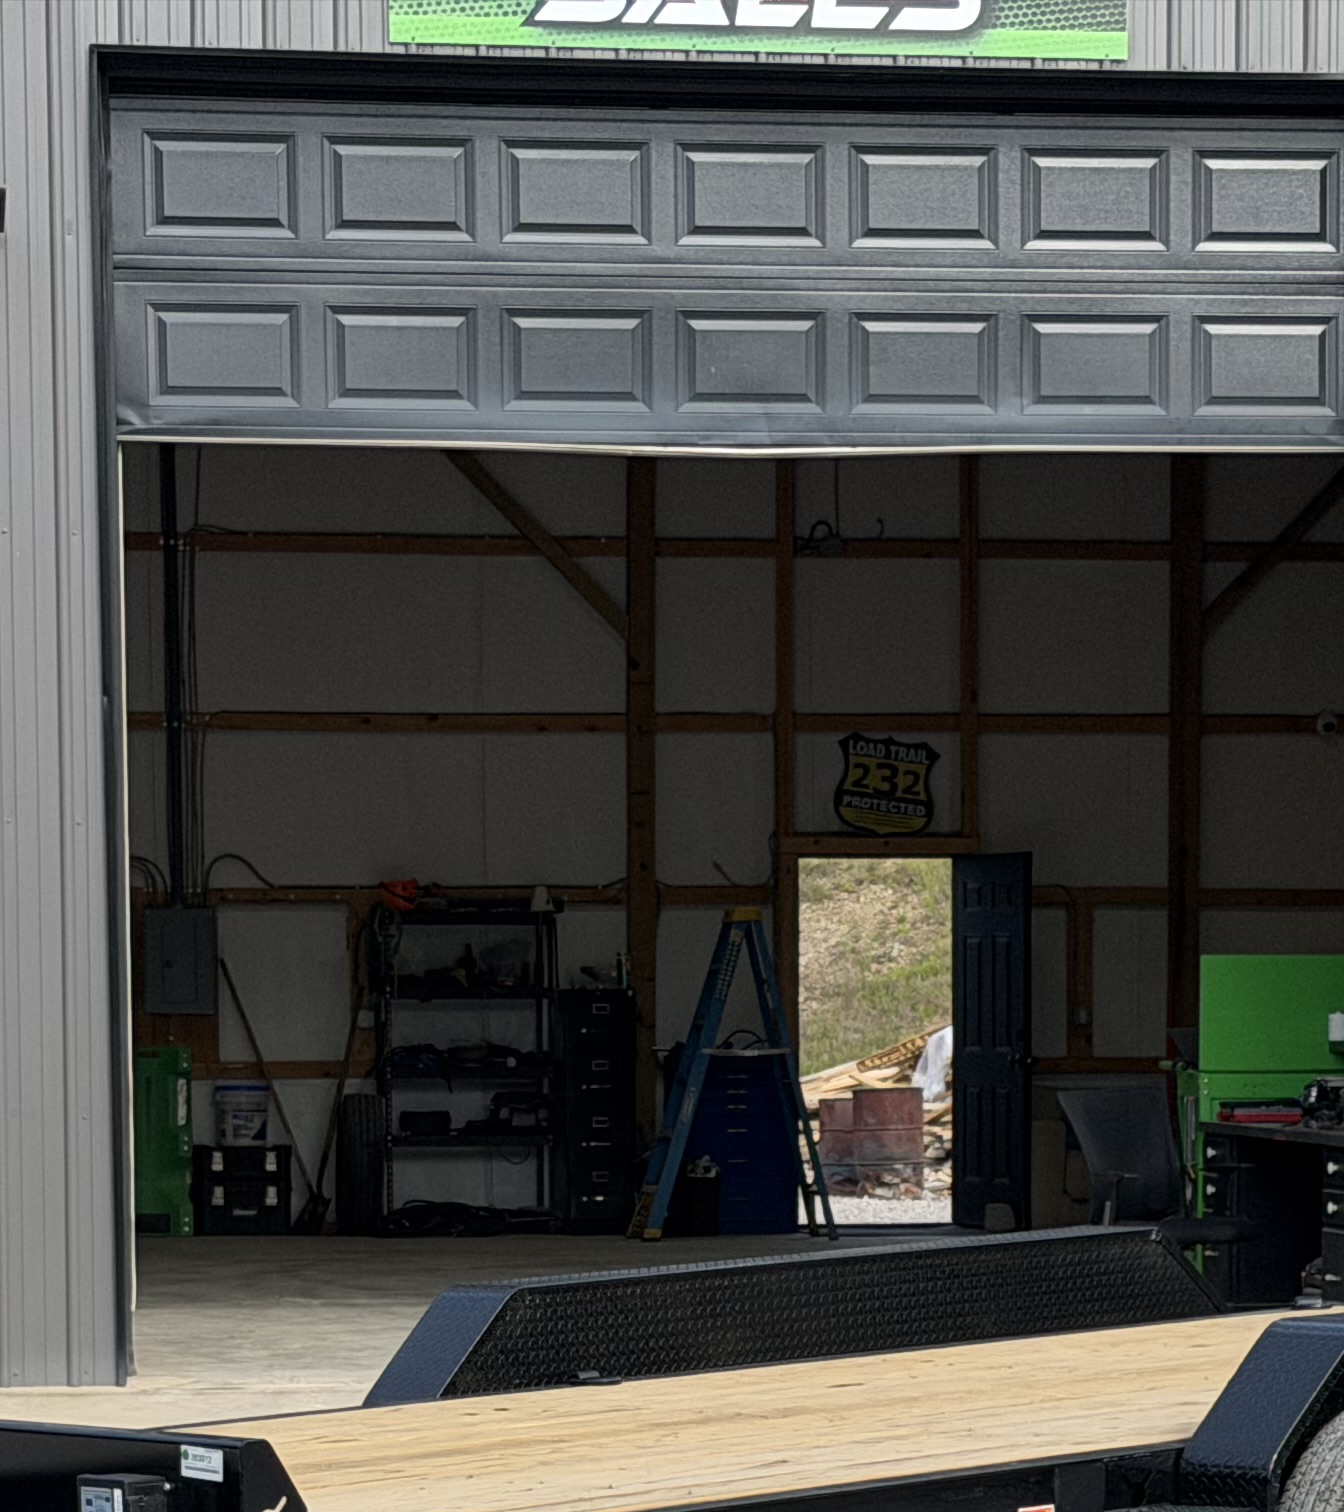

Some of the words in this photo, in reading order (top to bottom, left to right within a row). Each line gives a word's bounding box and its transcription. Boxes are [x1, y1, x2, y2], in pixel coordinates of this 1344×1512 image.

[849, 739, 886, 758] LOAD
[889, 744, 930, 764] TRAIL
[851, 761, 921, 797] 232
[842, 795, 926, 817] PROTECTED
